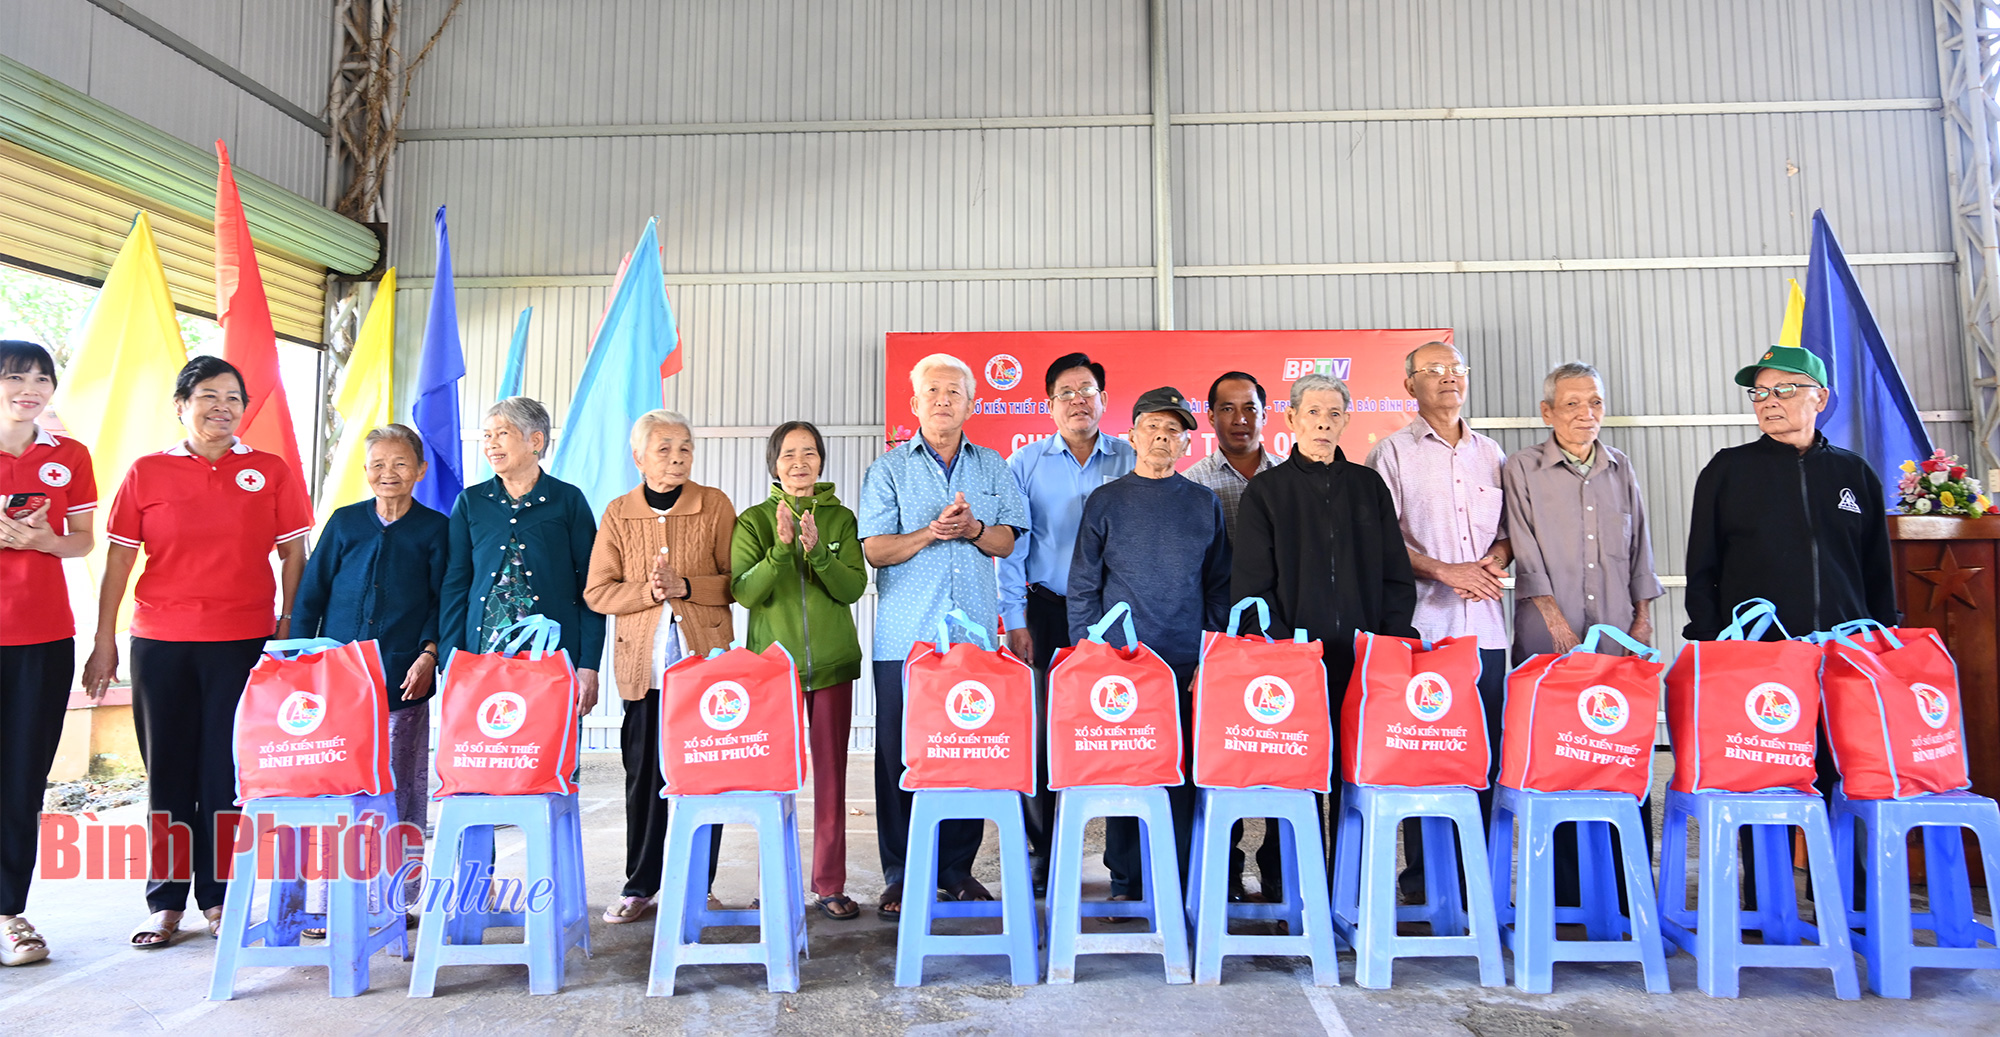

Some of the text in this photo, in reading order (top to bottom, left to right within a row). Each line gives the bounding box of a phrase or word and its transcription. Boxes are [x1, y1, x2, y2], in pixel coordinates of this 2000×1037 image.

[1284, 359, 1350, 380] BPTV
[984, 398, 1007, 414] KIẾN
[1009, 398, 1036, 414] THIẾT
[1357, 396, 1377, 412] BÁO
[1379, 396, 1403, 412] BÌNH
[700, 735, 714, 747] SỐ
[715, 733, 738, 746] KIẾN
[740, 730, 769, 743] THIẾT
[943, 732, 957, 744] SỐ
[958, 733, 981, 744] KIẾN
[982, 732, 1011, 744] THIẾT
[1090, 725, 1103, 737] SỐ
[1104, 725, 1127, 736] KIẾN
[1128, 724, 1156, 736] THIẾT
[1241, 726, 1255, 737] SỐ
[1256, 728, 1279, 739] KIẾN
[1280, 730, 1309, 742] THIẾT
[1403, 724, 1417, 736] SỐ
[1418, 725, 1440, 737] KIẾN
[1441, 726, 1468, 737] THIẾT
[276, 740, 289, 753] SỐ
[290, 738, 314, 751] KIẾN
[315, 735, 346, 749] THIẾT
[470, 741, 484, 753] SỐ
[485, 742, 509, 753] KIẾN
[510, 742, 541, 754] THIẾT
[1075, 736, 1157, 751] BÌNH PHƯỚC
[1224, 736, 1308, 756] BÌNH PHƯỚC
[1385, 734, 1467, 752] BÌNH PHƯỚC
[1573, 734, 1588, 745] SỐ
[1589, 738, 1613, 751] KIẾN
[1744, 735, 1759, 746] SỐ
[1760, 737, 1786, 750] KIẾN
[258, 749, 347, 769] BÌNH PHƯỚC
[684, 743, 770, 764] BÌNH PHƯỚC
[927, 744, 1010, 759] BÌNH PHƯỚC
[1555, 743, 1591, 762] BÌNH
[1724, 745, 1763, 762] BÌNH
[453, 754, 539, 769] BÌNH PHƯỚC
